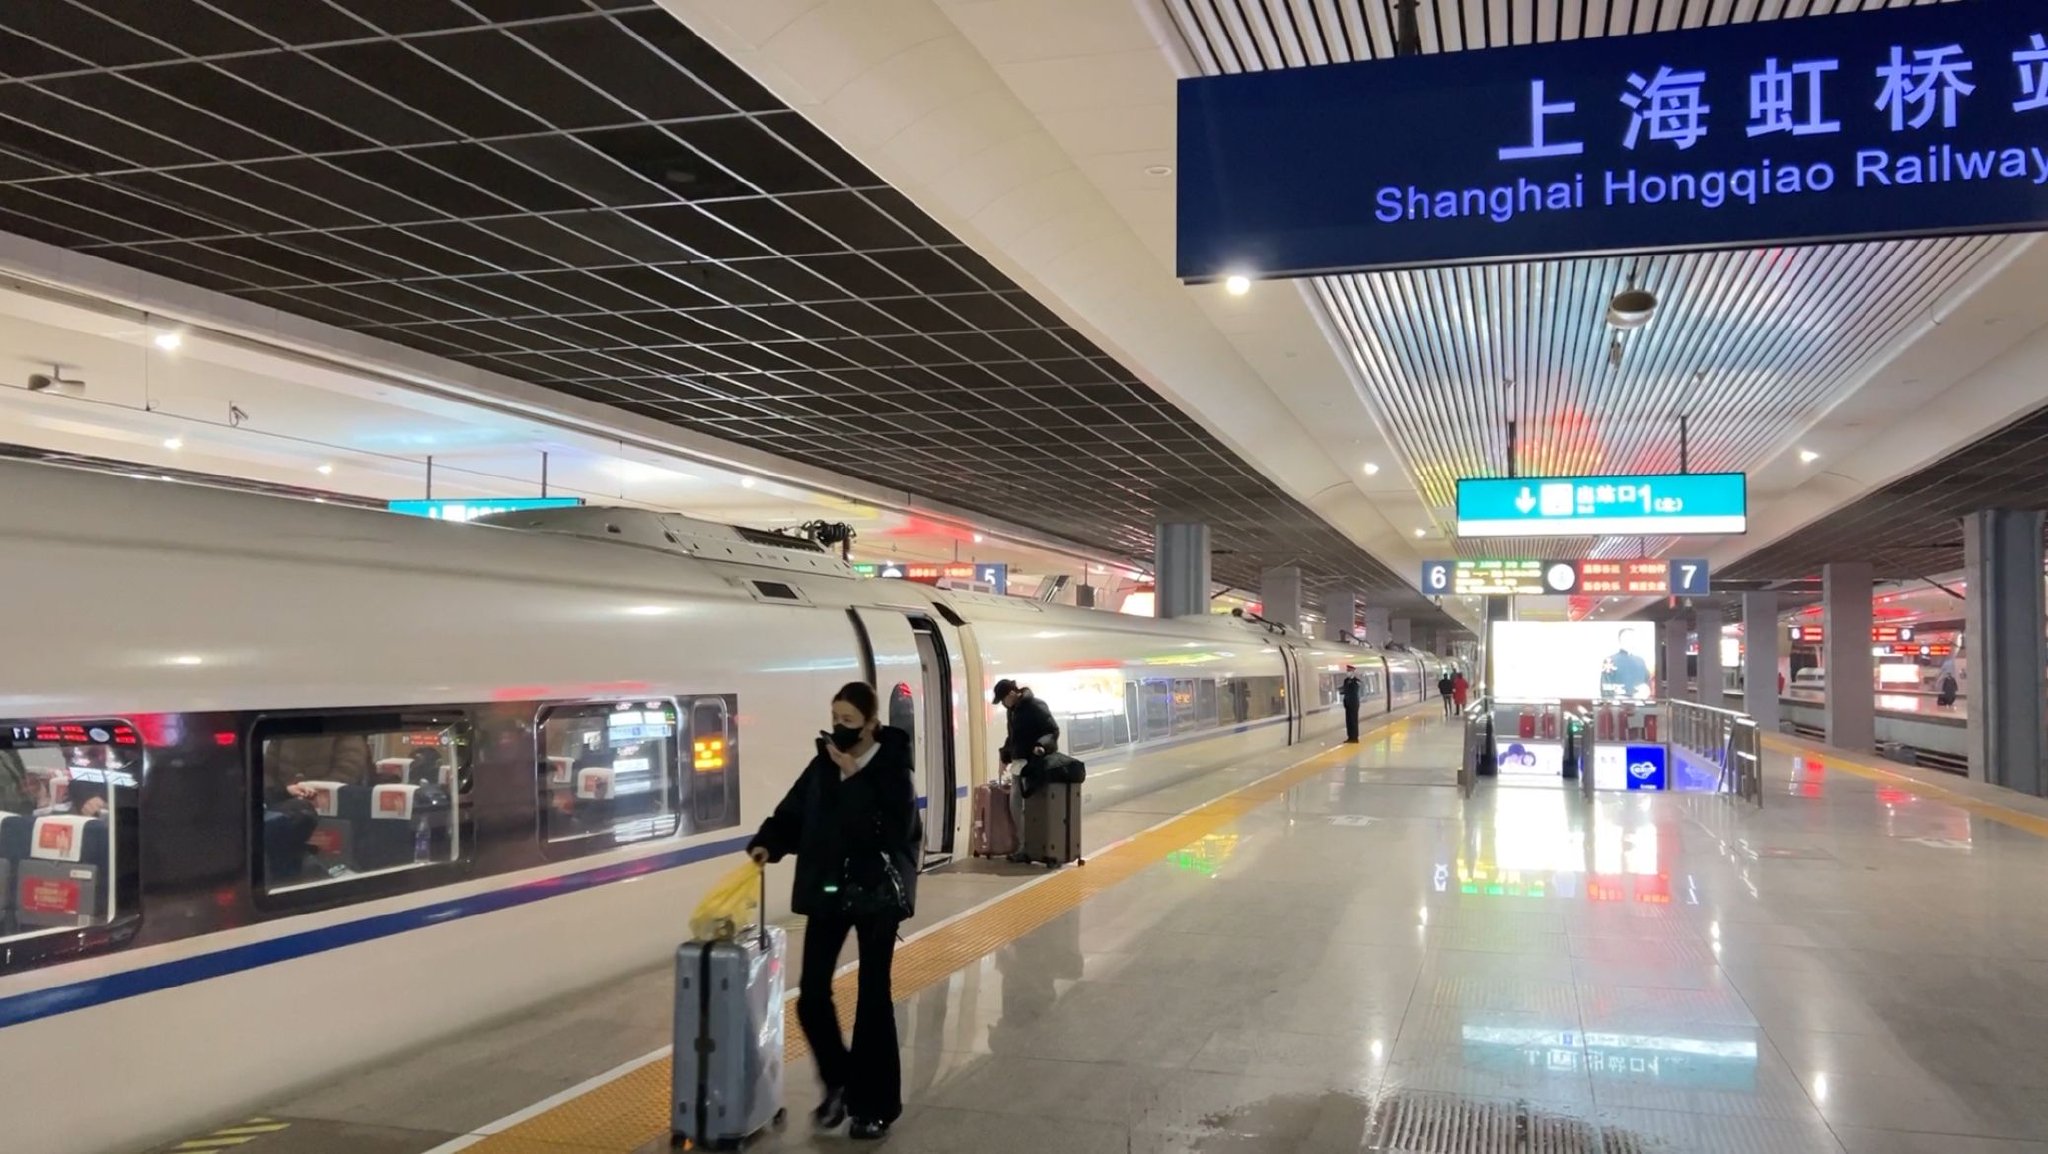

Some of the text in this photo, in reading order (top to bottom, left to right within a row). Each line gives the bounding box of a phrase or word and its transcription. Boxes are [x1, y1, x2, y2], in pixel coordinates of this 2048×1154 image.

[1376, 144, 2048, 222] Shanghai Hongqiao Railway
[984, 568, 996, 585] 5
[1430, 565, 1446, 589] 6
[1681, 565, 1697, 589] 7
